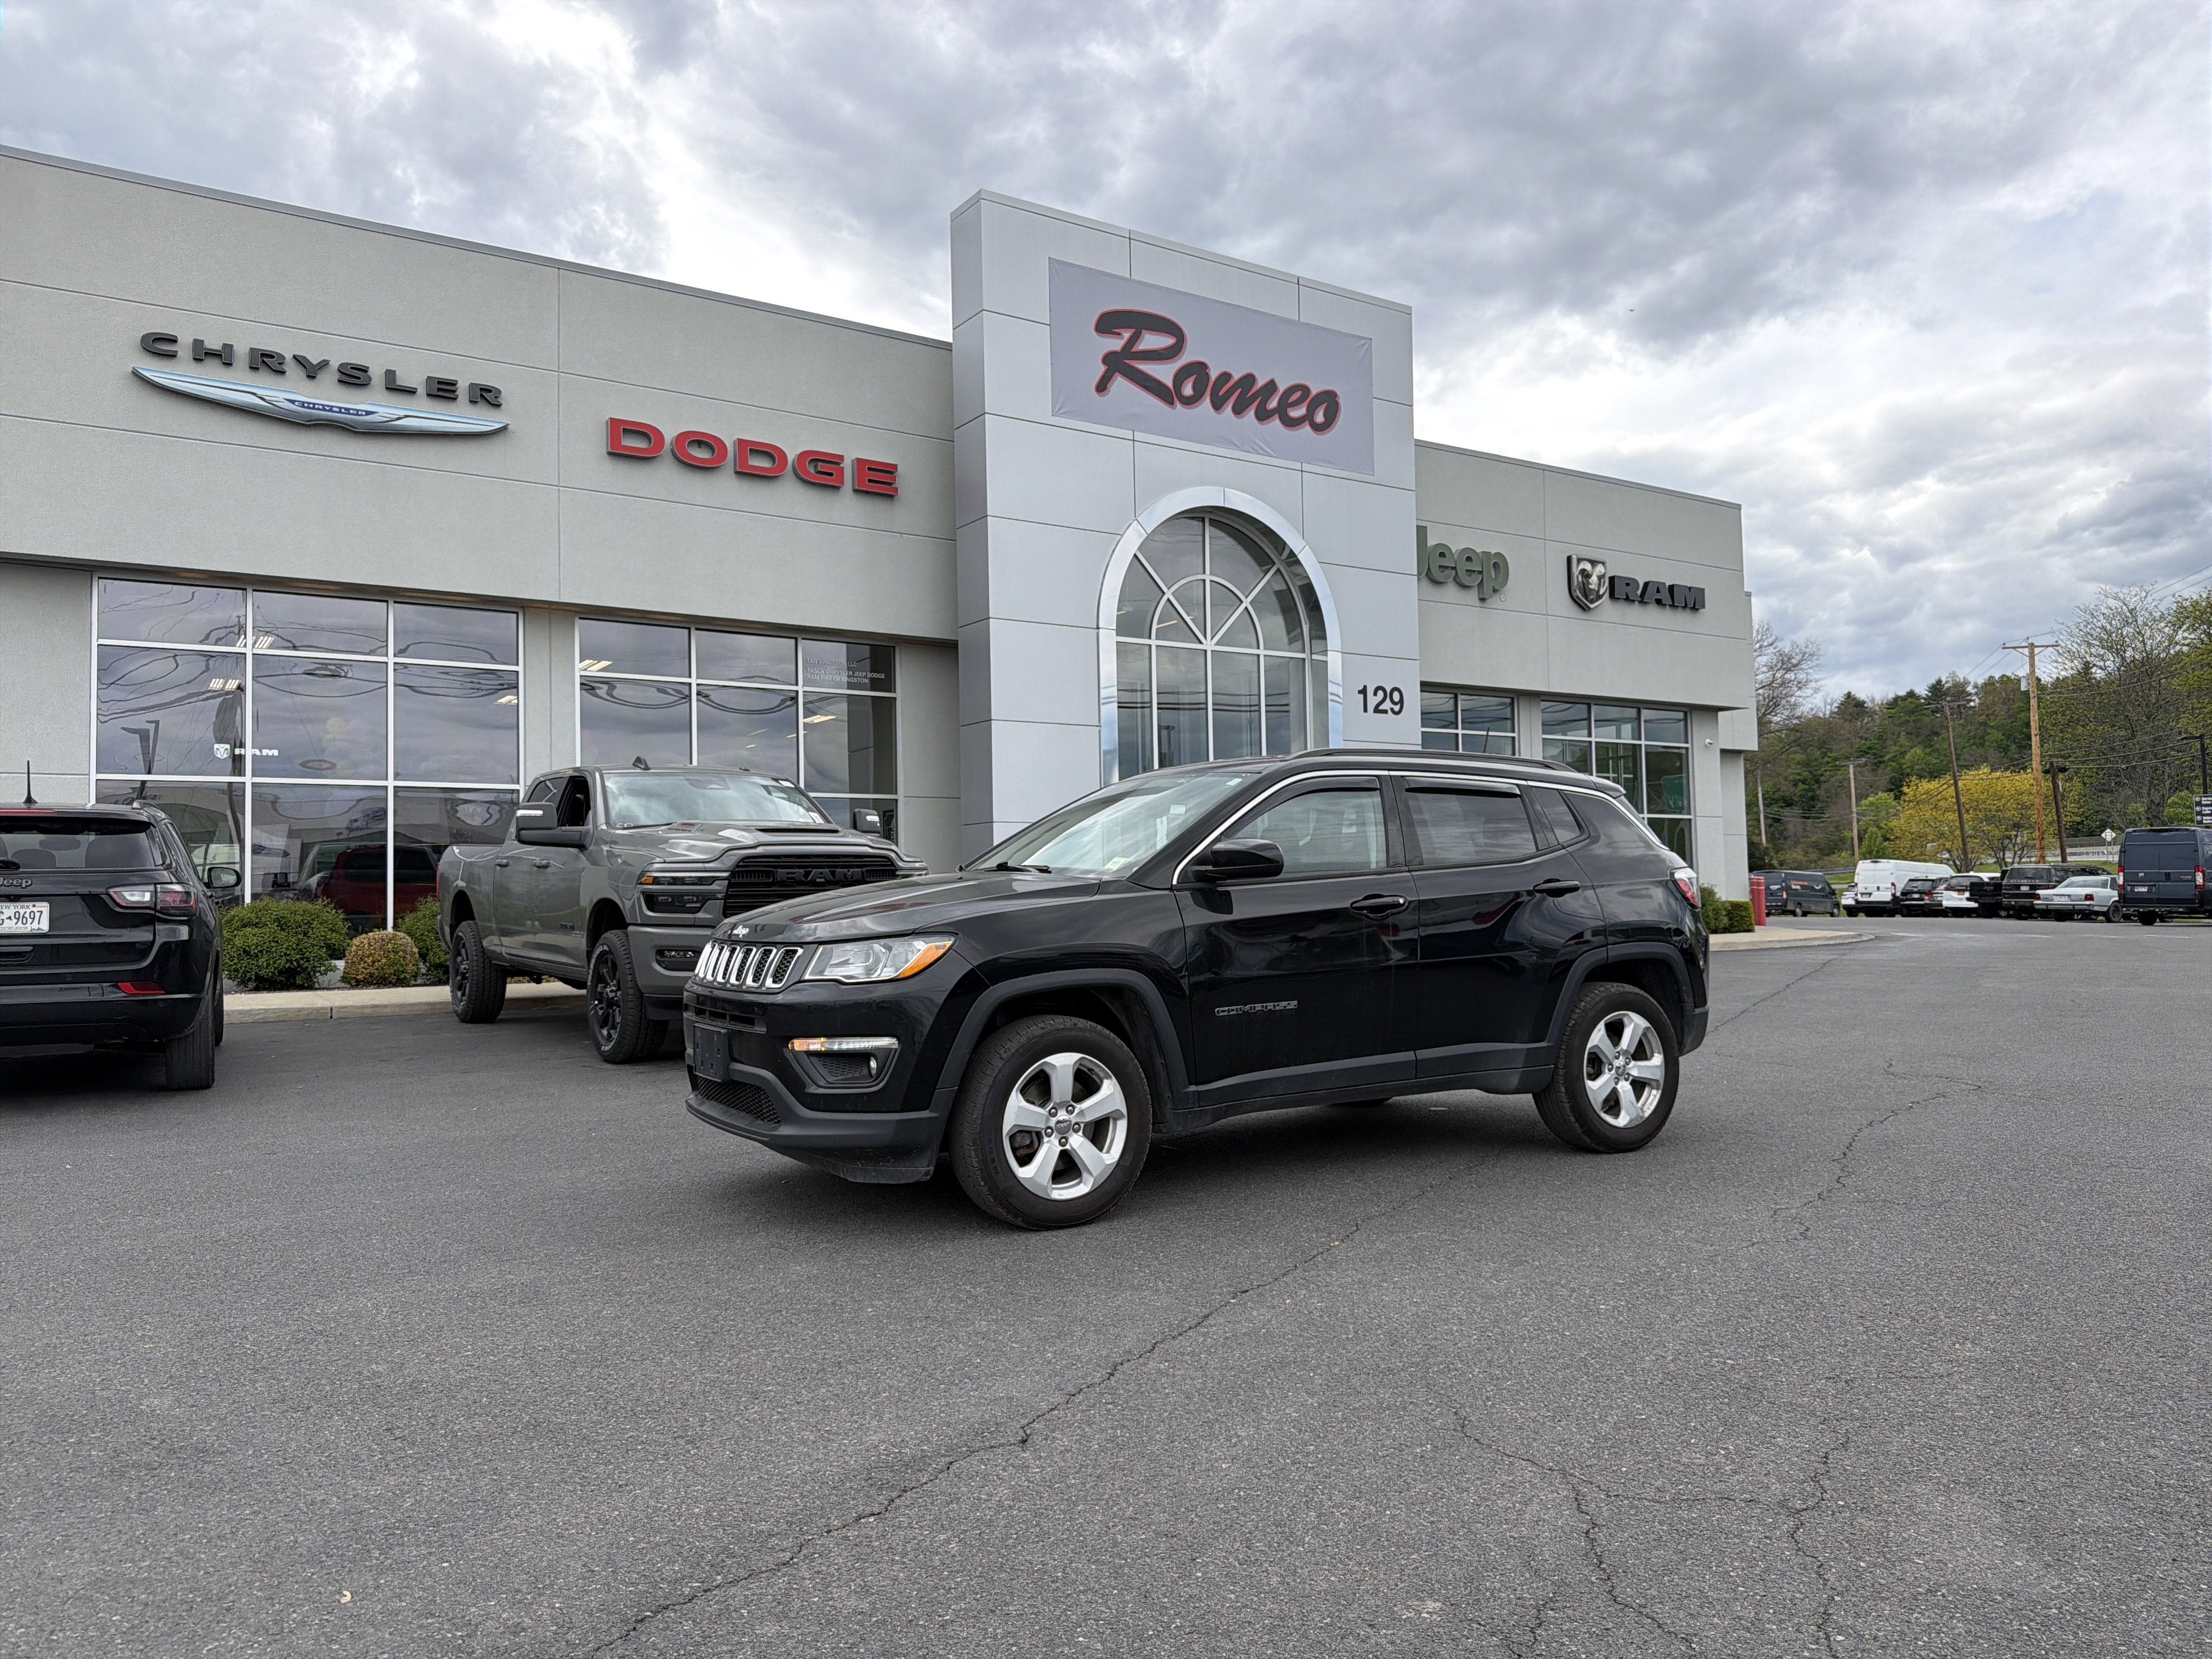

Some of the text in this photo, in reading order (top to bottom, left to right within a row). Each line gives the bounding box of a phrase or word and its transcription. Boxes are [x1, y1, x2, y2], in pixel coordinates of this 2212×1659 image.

[140, 331, 503, 407] CHRYSLER
[1094, 308, 1341, 434] Romeo
[295, 402, 366, 415] CHRYSLER
[606, 417, 899, 496] DODGE
[1609, 575, 1705, 610] RAM
[1358, 685, 1404, 715] 129
[234, 748, 279, 756] RAM
[777, 869, 862, 882] RAM
[14, 910, 43, 926] 9697
[1215, 1000, 1298, 1016] COMPASS
